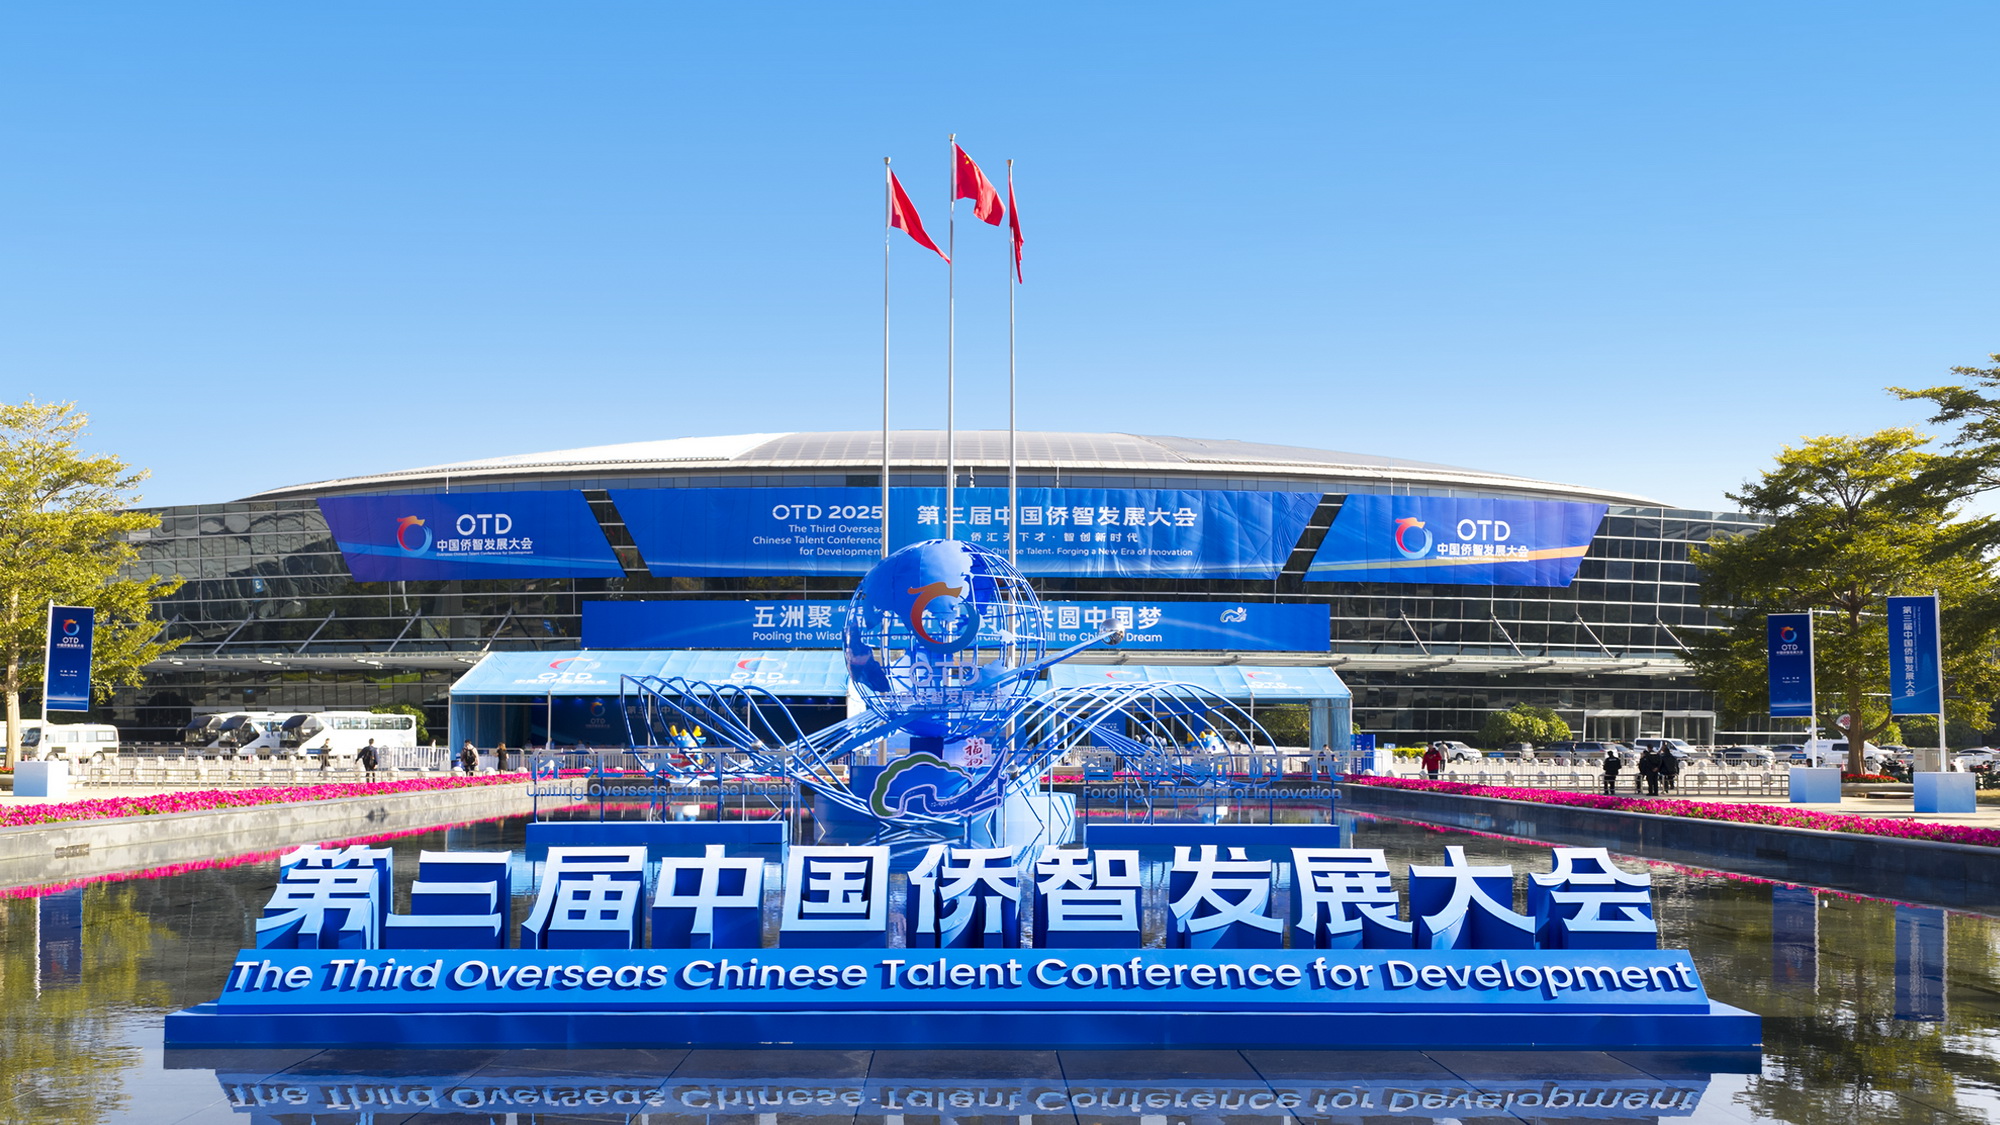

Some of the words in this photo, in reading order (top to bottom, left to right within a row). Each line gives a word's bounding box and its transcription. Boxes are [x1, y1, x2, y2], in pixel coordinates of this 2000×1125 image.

[772, 504, 822, 520] OTD
[828, 505, 884, 519] 2025
[917, 505, 1198, 527] 第三届中国侨智发展大会
[456, 513, 512, 536] OTD
[788, 525, 807, 533] The
[810, 525, 836, 533] Third
[838, 525, 884, 533] Overseas
[1457, 518, 1511, 541] OTD
[437, 537, 533, 552] 中国侨智发展大会
[752, 536, 792, 545] Chinese
[794, 535, 825, 545] Talent
[826, 536, 884, 545] Conference
[799, 547, 814, 556] for
[816, 547, 884, 557] Development
[992, 547, 1025, 555] Chinse
[1057, 547, 1090, 557] Forging
[1099, 547, 1119, 556] New
[1120, 547, 1135, 556] Era
[1137, 548, 1147, 556] of
[1148, 548, 1193, 556] Innovation
[1437, 542, 1530, 558] 中国侨智发展大会
[62, 636, 80, 644] OTD
[752, 631, 793, 643] Pooling
[795, 631, 814, 641] the
[816, 631, 843, 641] Wisd
[1059, 632, 1077, 642] the
[1126, 632, 1163, 643] Dream
[537, 672, 593, 680] OTD
[730, 672, 784, 680] OTD
[909, 661, 980, 686] OTD
[526, 784, 584, 801] Uniting
[589, 784, 667, 797] Overseas
[672, 784, 740, 797] Chinese
[1083, 785, 1145, 803] Forging
[1233, 785, 1252, 799] of
[1254, 785, 1342, 799] Innovation
[255, 844, 1653, 938] 第三届中国侨智发展大会
[234, 959, 313, 990] The
[329, 958, 443, 989] Third
[454, 960, 668, 990] Overseas
[682, 958, 867, 989] Chinese
[882, 958, 1023, 988] Talent
[1035, 957, 1301, 988] Conference
[1313, 957, 1374, 988] for
[1390, 958, 1697, 998] Development
